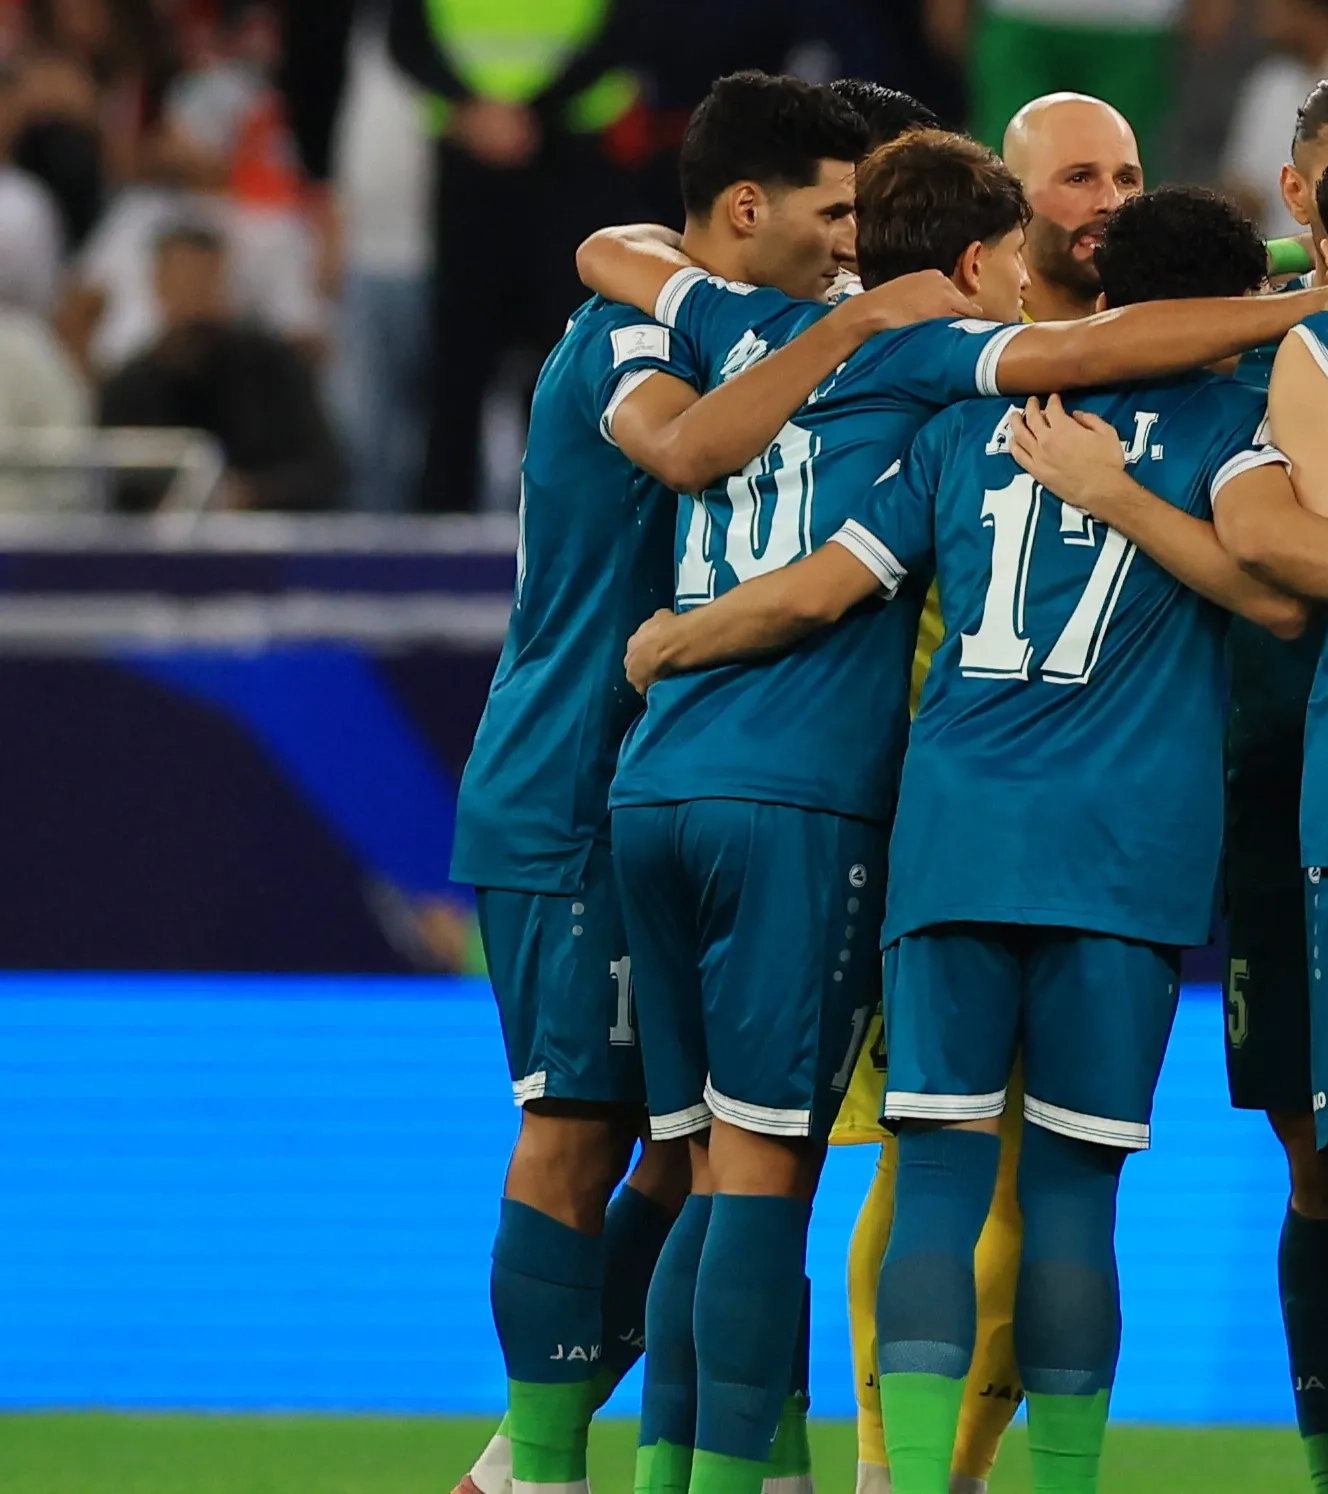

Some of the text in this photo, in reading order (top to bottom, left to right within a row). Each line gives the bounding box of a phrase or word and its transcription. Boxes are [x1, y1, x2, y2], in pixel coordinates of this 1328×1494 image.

[675, 421, 822, 606] 10
[958, 473, 1137, 685] 17
[1228, 958, 1250, 1050] 5
[549, 1343, 602, 1361] JAK
